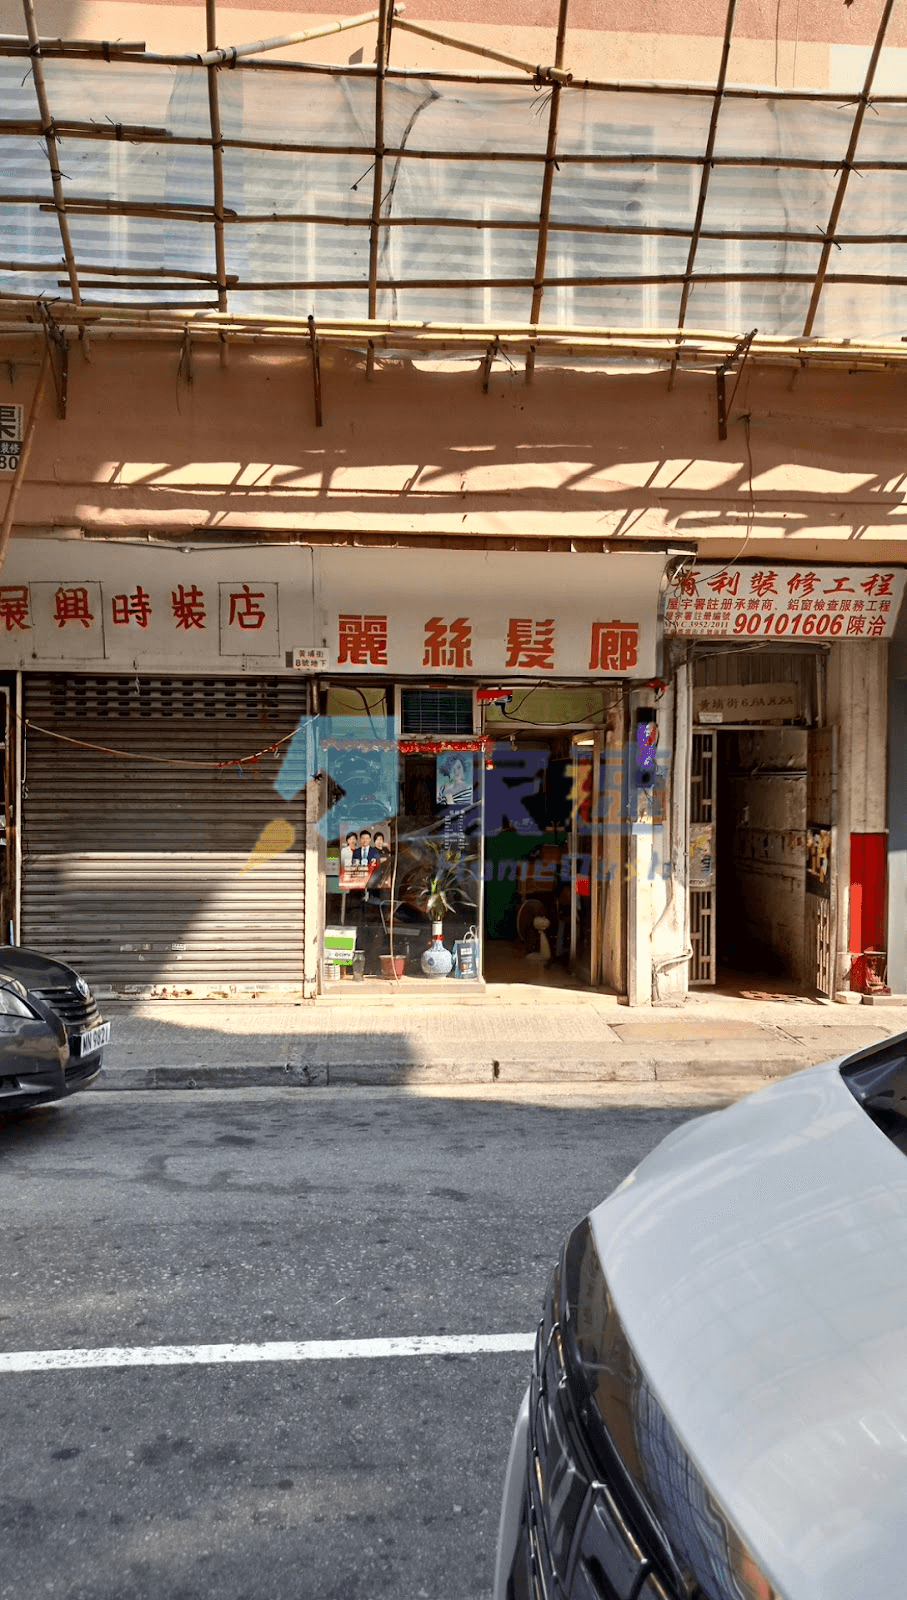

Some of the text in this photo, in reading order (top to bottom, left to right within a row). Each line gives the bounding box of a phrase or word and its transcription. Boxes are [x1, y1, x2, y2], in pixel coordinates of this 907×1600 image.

[337, 614, 639, 671] 麗絲髮廊
[732, 613, 844, 635] 90101606
